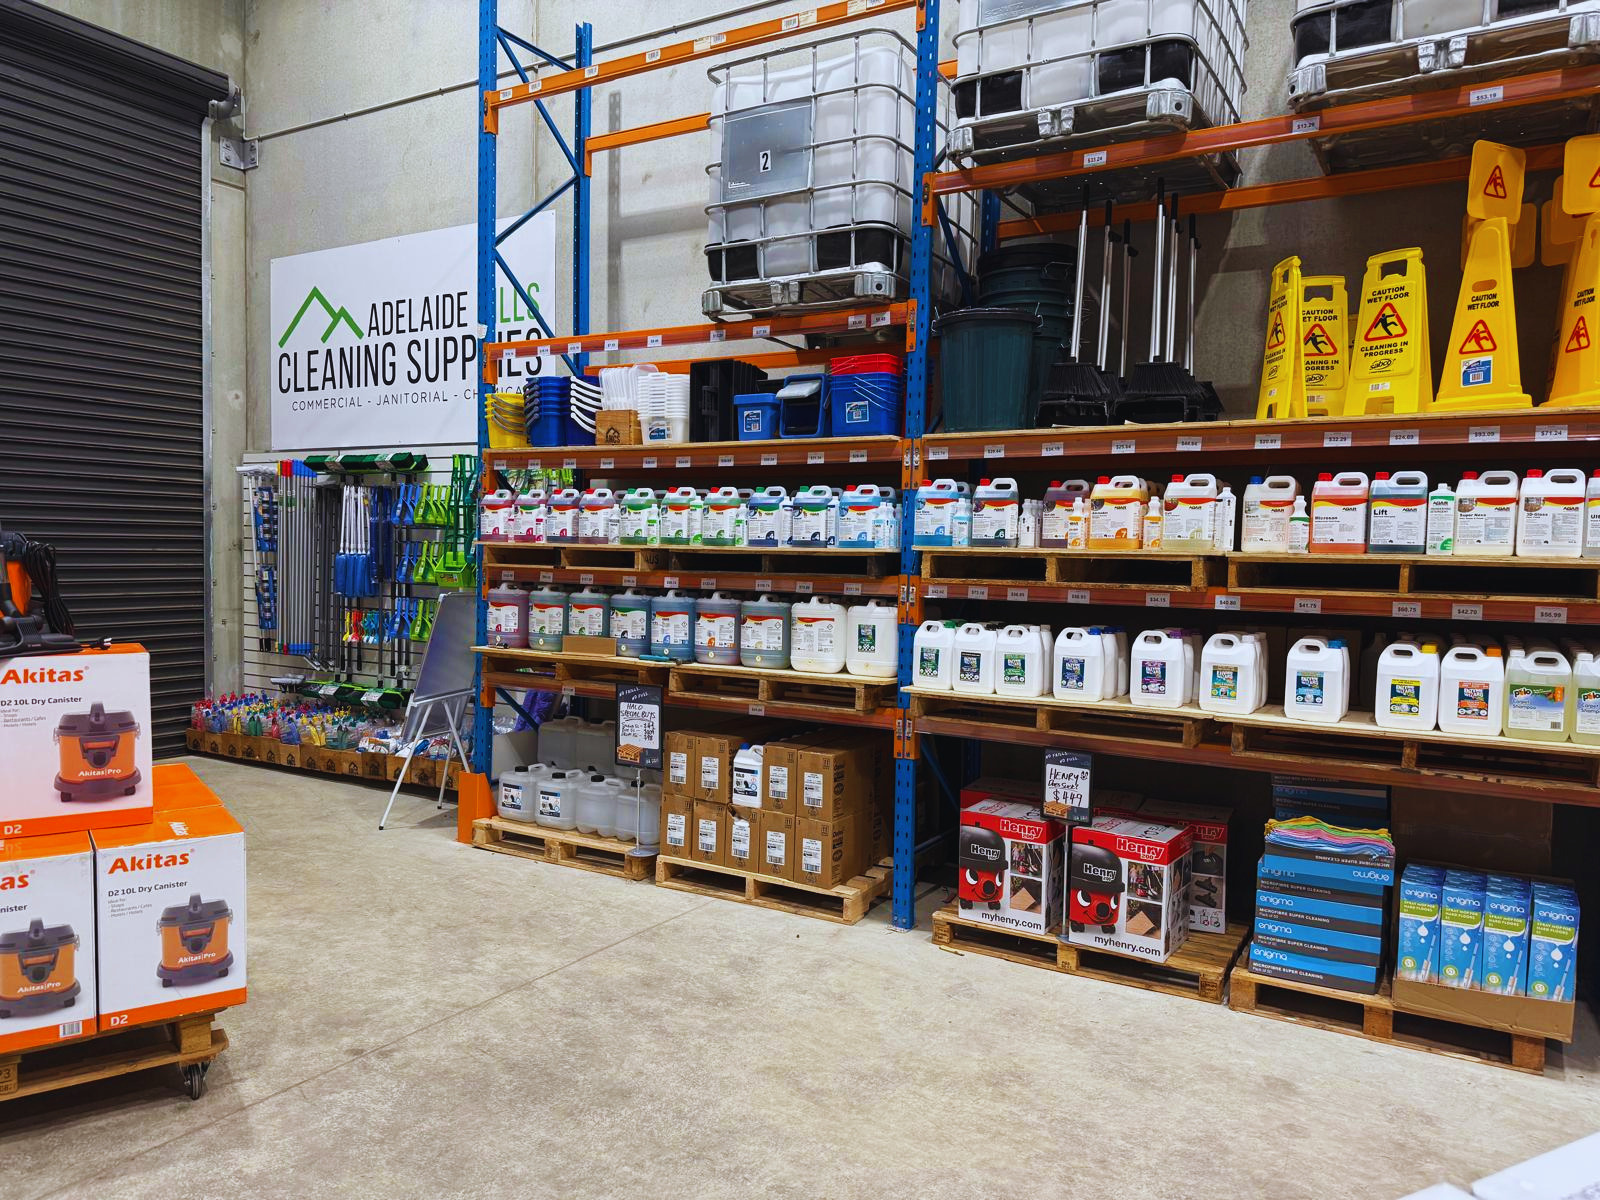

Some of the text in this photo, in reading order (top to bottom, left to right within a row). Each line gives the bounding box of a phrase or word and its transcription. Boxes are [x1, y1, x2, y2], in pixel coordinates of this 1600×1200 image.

[762, 153, 769, 171] 2
[1372, 286, 1405, 297] CAUTION
[1471, 293, 1497, 302] CAUTION
[1577, 288, 1595, 298] CAUTION
[1272, 295, 1286, 306] CAUTION
[1367, 292, 1409, 304] WET FLOOR
[367, 282, 541, 338] ADELAIDE LLS
[1480, 301, 1499, 309] FLOOR
[1360, 342, 1398, 352] CLEANING
[1364, 348, 1404, 357] PROGRESS
[278, 328, 543, 394] CLEANING SUPPIES
[292, 391, 448, 411] COMMERCIAL JANITORIAL
[0, 667, 84, 684] Akitas
[1513, 687, 1532, 697] polo
[31, 697, 46, 706] Dry
[48, 696, 83, 704] Canister
[627, 703, 643, 711] HALO
[1050, 768, 1079, 785] HENRY
[4, 824, 22, 835] D2
[1000, 819, 1043, 838] Henry
[971, 844, 1000, 859] Henry
[1116, 838, 1164, 859] Henry
[108, 853, 190, 874] Akitas
[1083, 863, 1116, 881] Henry
[1260, 866, 1296, 877] enigma
[1353, 870, 1390, 881] enigma
[138, 885, 152, 893] Dry
[154, 881, 188, 891] Canister
[1405, 889, 1438, 899] enigma
[1260, 895, 1294, 906] enigma
[1446, 896, 1481, 907] enigma
[0, 904, 28, 913] nister
[1489, 903, 1525, 913] enigma
[981, 912, 1042, 930] myhenry.com
[1259, 907, 1288, 916] MICROFIBRE
[1305, 915, 1330, 923] CLEANING
[1538, 910, 1575, 922] enigma
[1258, 922, 1293, 934] enigma
[1094, 936, 1161, 956] myhenry.com
[1258, 935, 1287, 944] MICROFIBRE
[1304, 943, 1329, 951] CLEANING
[1253, 948, 1288, 960] enigma
[1252, 962, 1282, 971] MICROFIBRE
[1298, 971, 1324, 980] CLEANING
[110, 1015, 128, 1026] D2
